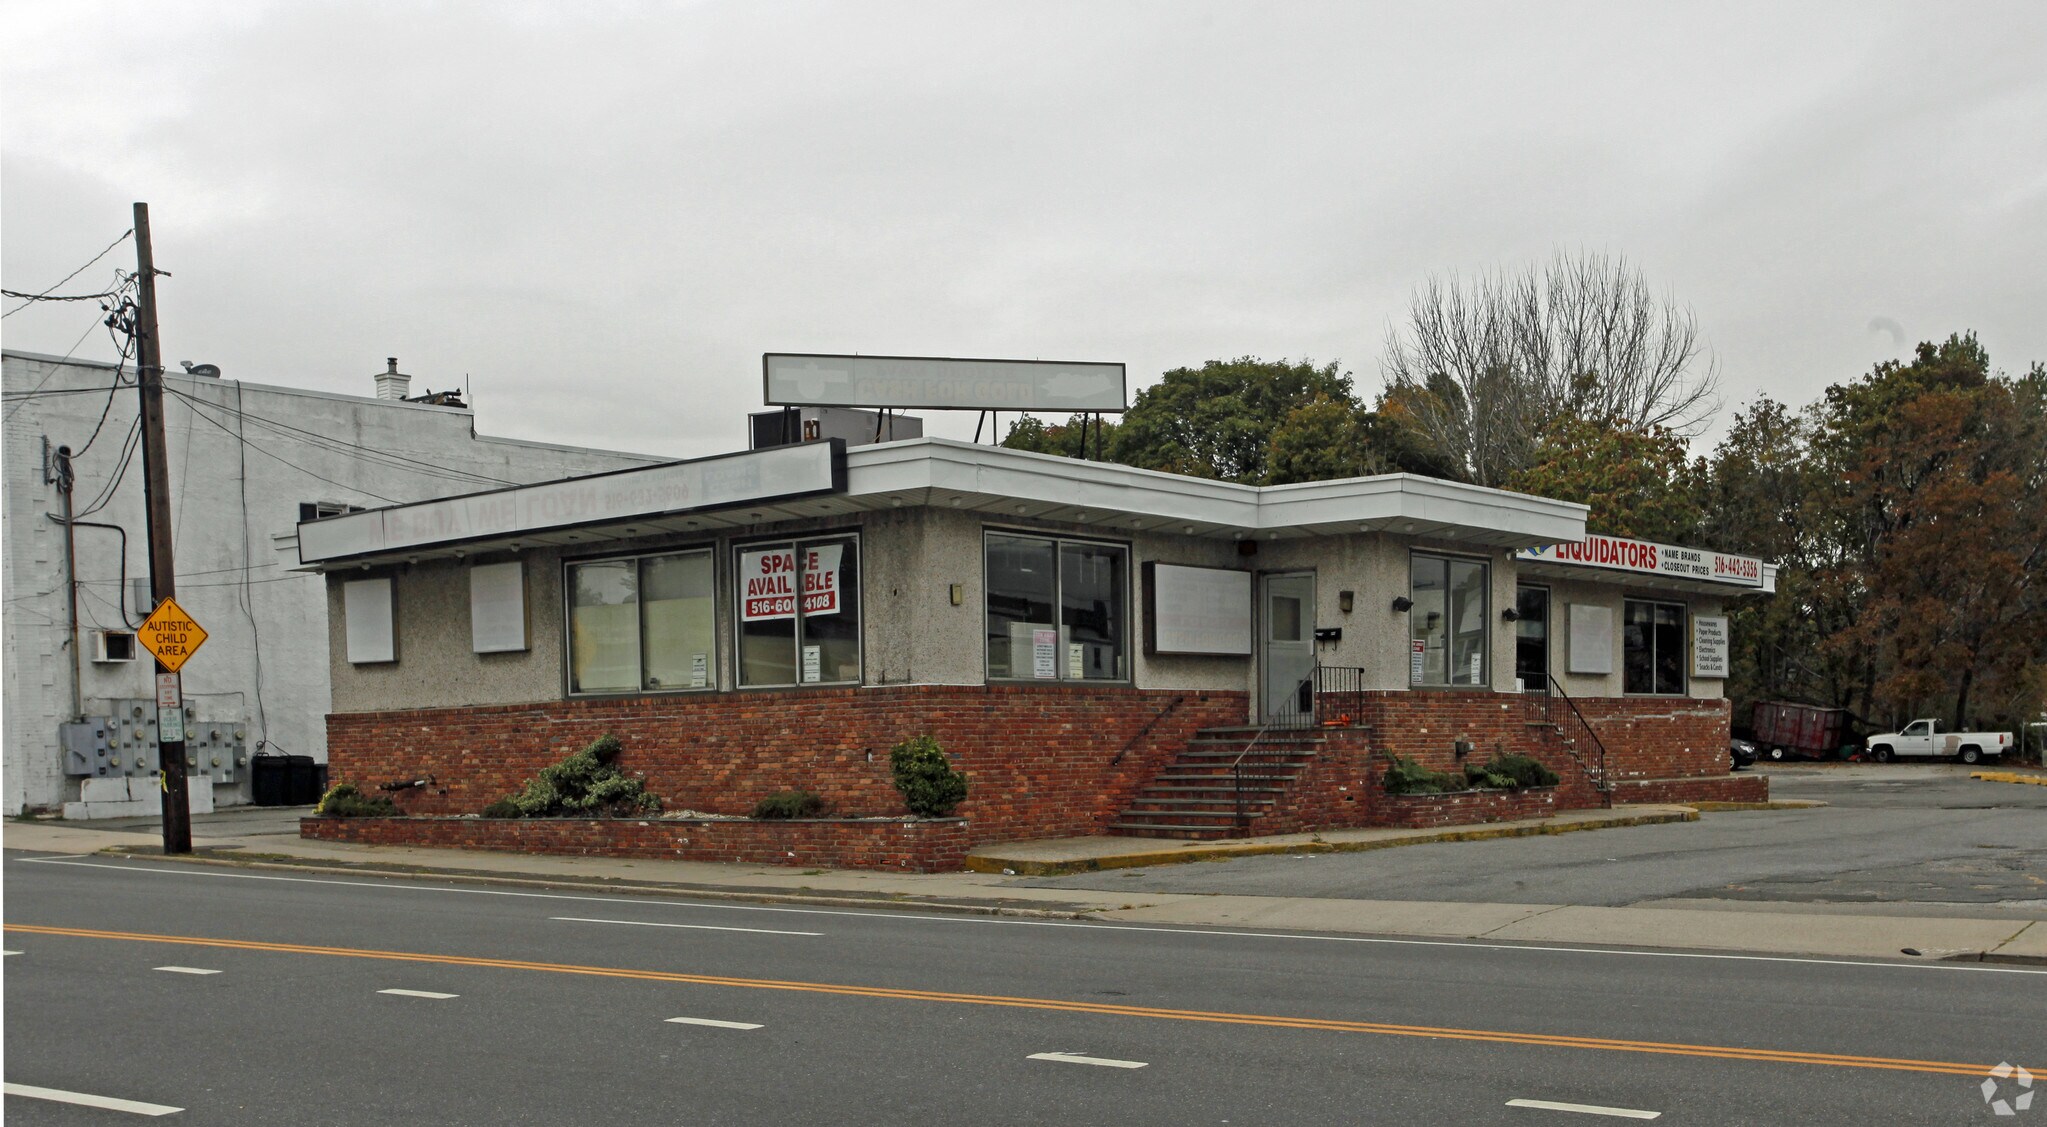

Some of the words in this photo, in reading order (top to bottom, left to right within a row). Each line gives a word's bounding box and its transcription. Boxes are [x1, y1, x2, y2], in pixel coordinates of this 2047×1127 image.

[1555, 537, 1657, 569] LIQUIDATORS
[1664, 549, 1679, 559] NAME
[1681, 551, 1701, 562] BRANDS
[1664, 561, 1690, 573] CLOSEOUT
[1692, 565, 1709, 576] PRICES
[1714, 556, 1758, 578] 516-442-5356
[748, 571, 834, 597] AVAILBLE
[147, 621, 193, 632] AUTISTIC
[155, 633, 188, 644] CHILD
[1699, 637, 1712, 646] Cleaning
[157, 646, 188, 656] AREA
[1710, 655, 1723, 663] Supplies
